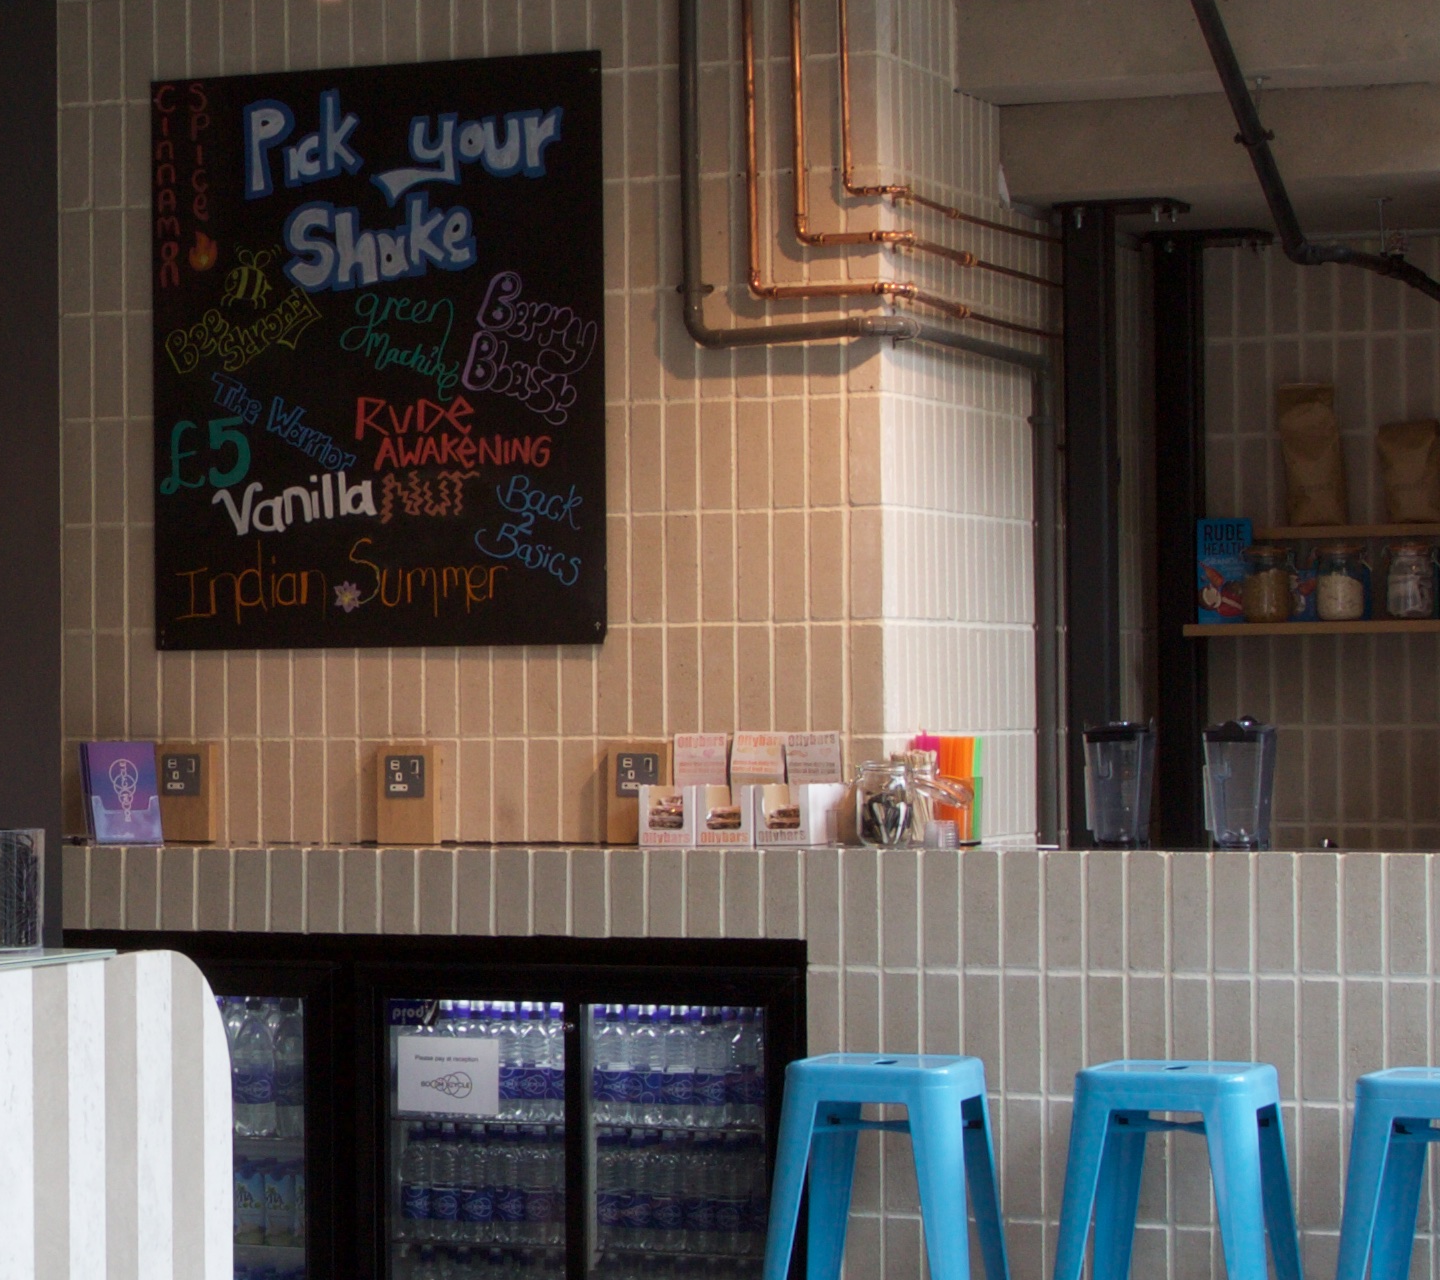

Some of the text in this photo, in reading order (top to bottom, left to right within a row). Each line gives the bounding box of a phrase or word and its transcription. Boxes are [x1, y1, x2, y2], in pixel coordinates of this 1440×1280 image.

[243, 88, 564, 208] Pick your
[283, 191, 478, 293] Shake
[211, 371, 357, 470] The Warrior
[159, 415, 251, 495] £5
[211, 470, 378, 536] Vanilla
[495, 474, 583, 531] Back
[517, 512, 536, 536] 2
[1203, 523, 1246, 541] RUDE
[1203, 542, 1245, 556] HEALTH
[174, 537, 509, 625] Indian Summer
[642, 832, 691, 844] Ollybars
[700, 831, 749, 843] Ollybars
